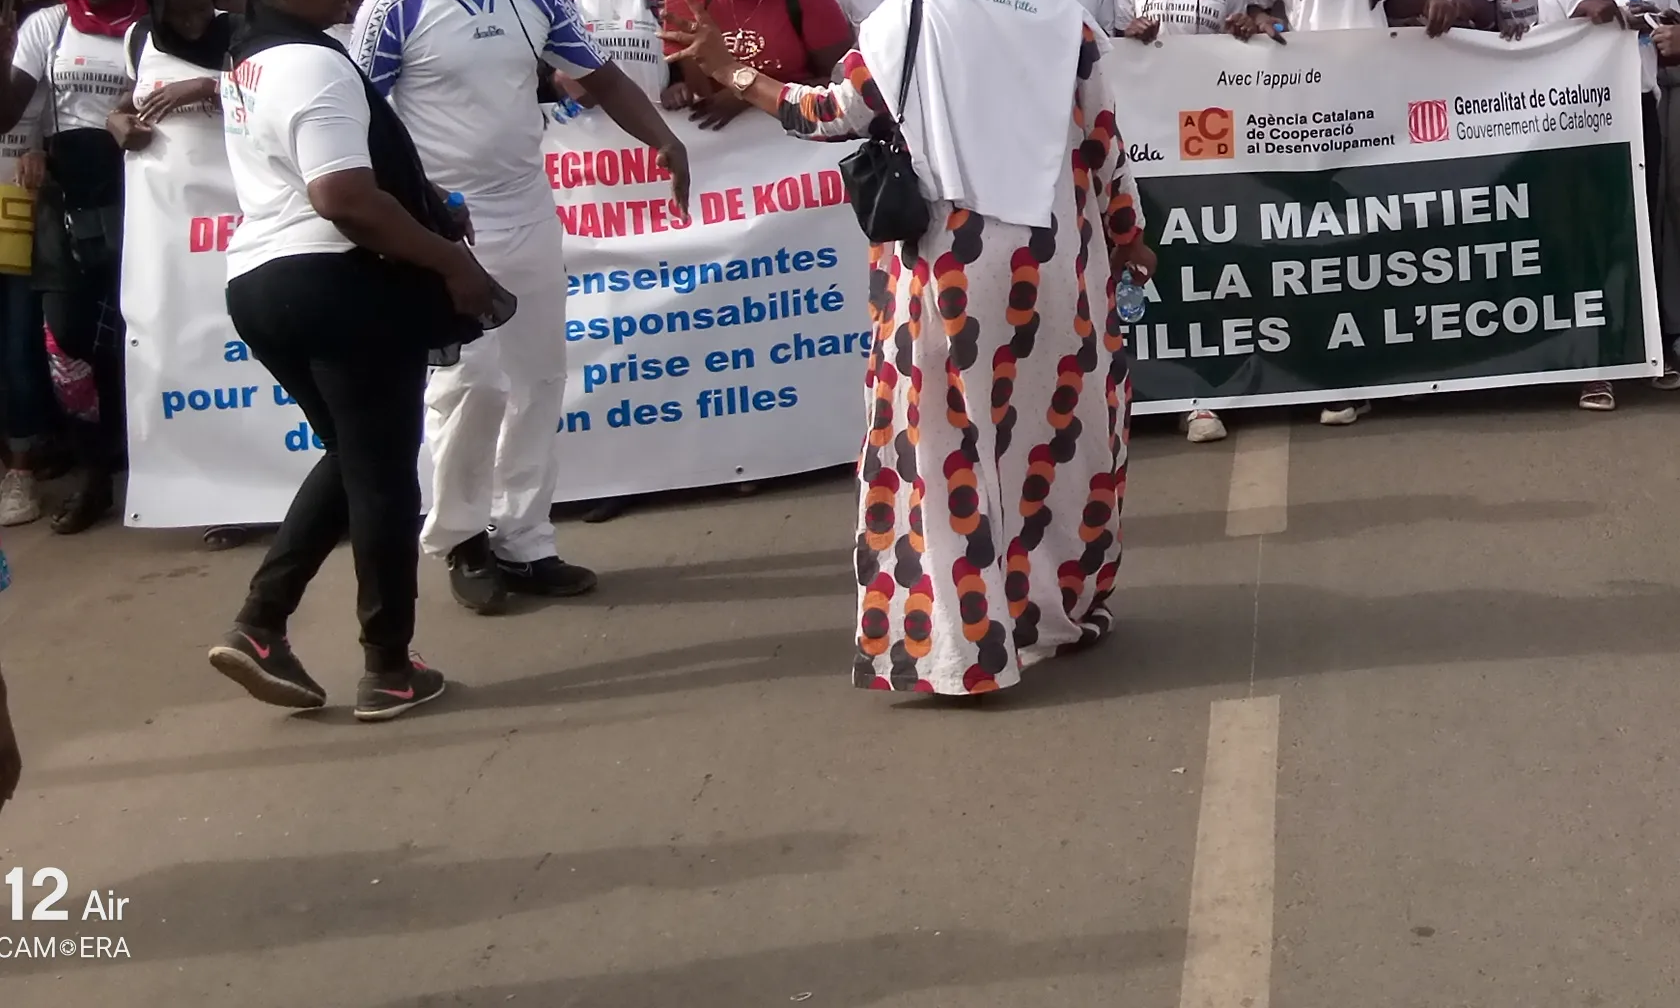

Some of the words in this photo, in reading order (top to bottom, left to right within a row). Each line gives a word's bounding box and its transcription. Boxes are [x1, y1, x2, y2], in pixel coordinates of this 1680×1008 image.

[1217, 70, 1252, 87] Avec
[1256, 69, 1301, 89] l'appui
[1305, 68, 1322, 84] de
[1246, 112, 1308, 128] Agència
[1312, 107, 1375, 124] Catalana
[1454, 91, 1526, 116] Generalitat
[1530, 90, 1545, 108] de
[1549, 84, 1612, 107] Catalunya
[1247, 128, 1266, 140] de
[1269, 123, 1354, 140] Cooperació
[1456, 118, 1539, 140] Gouvernement
[1542, 116, 1557, 133] de
[1560, 110, 1613, 133] Catalogne
[1247, 142, 1261, 154] al
[1264, 134, 1395, 156] Desenvolupament
[700, 187, 746, 225] DE
[1160, 205, 1238, 245] AU
[1260, 183, 1531, 242] MAINTIEN
[1181, 264, 1252, 303] LA
[1272, 240, 1543, 297] REUSSITE
[1328, 313, 1364, 350] A
[1384, 290, 1606, 345] L'ECOLE
[583, 353, 690, 392] prise
[705, 347, 754, 372] en
[162, 384, 258, 419] pour
[607, 399, 682, 428] des
[697, 385, 798, 418] filles
